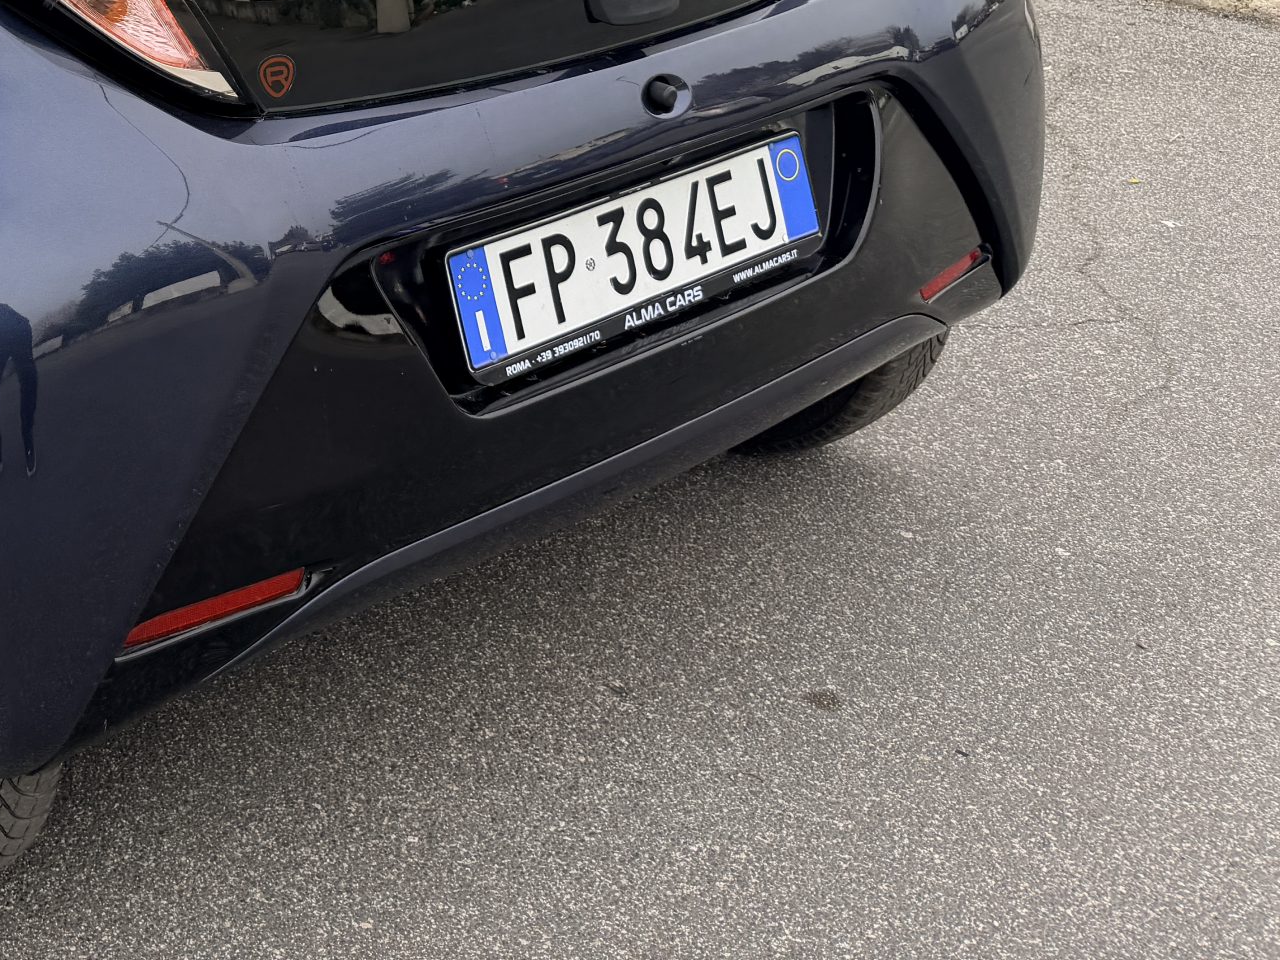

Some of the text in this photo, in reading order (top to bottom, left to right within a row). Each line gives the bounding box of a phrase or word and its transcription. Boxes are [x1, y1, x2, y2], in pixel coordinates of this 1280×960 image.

[732, 248, 798, 284] WWW.ALMACARS.IT
[624, 285, 704, 330] ALMA CARS
[505, 359, 532, 377] ROMA
[536, 349, 553, 363] +39
[553, 330, 601, 357] 3930921170
